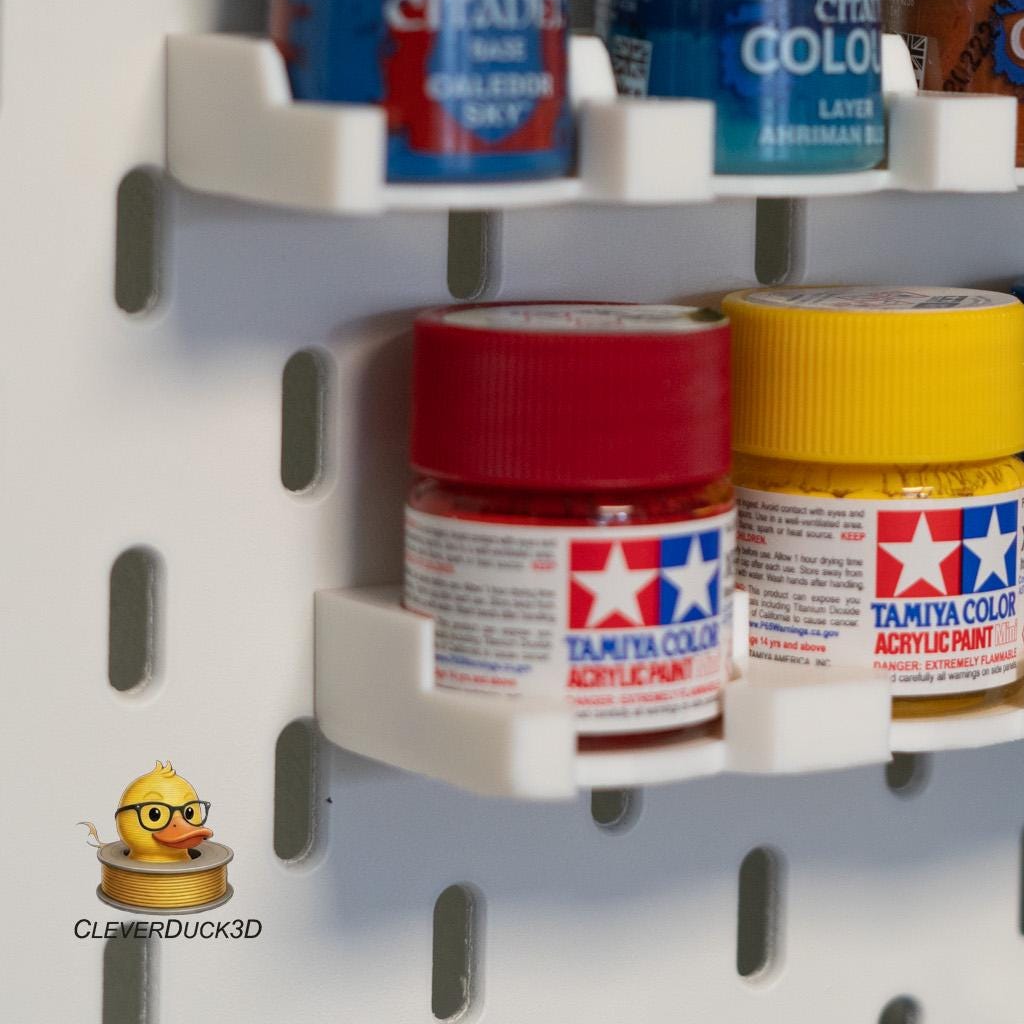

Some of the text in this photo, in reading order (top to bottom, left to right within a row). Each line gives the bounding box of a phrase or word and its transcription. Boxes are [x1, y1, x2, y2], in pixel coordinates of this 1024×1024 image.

[871, 591, 1016, 628] TAMIYA COLOR
[874, 630, 949, 655] ACRYLIC
[952, 626, 993, 652] PAINT
[925, 655, 980, 670] EXTREMELY
